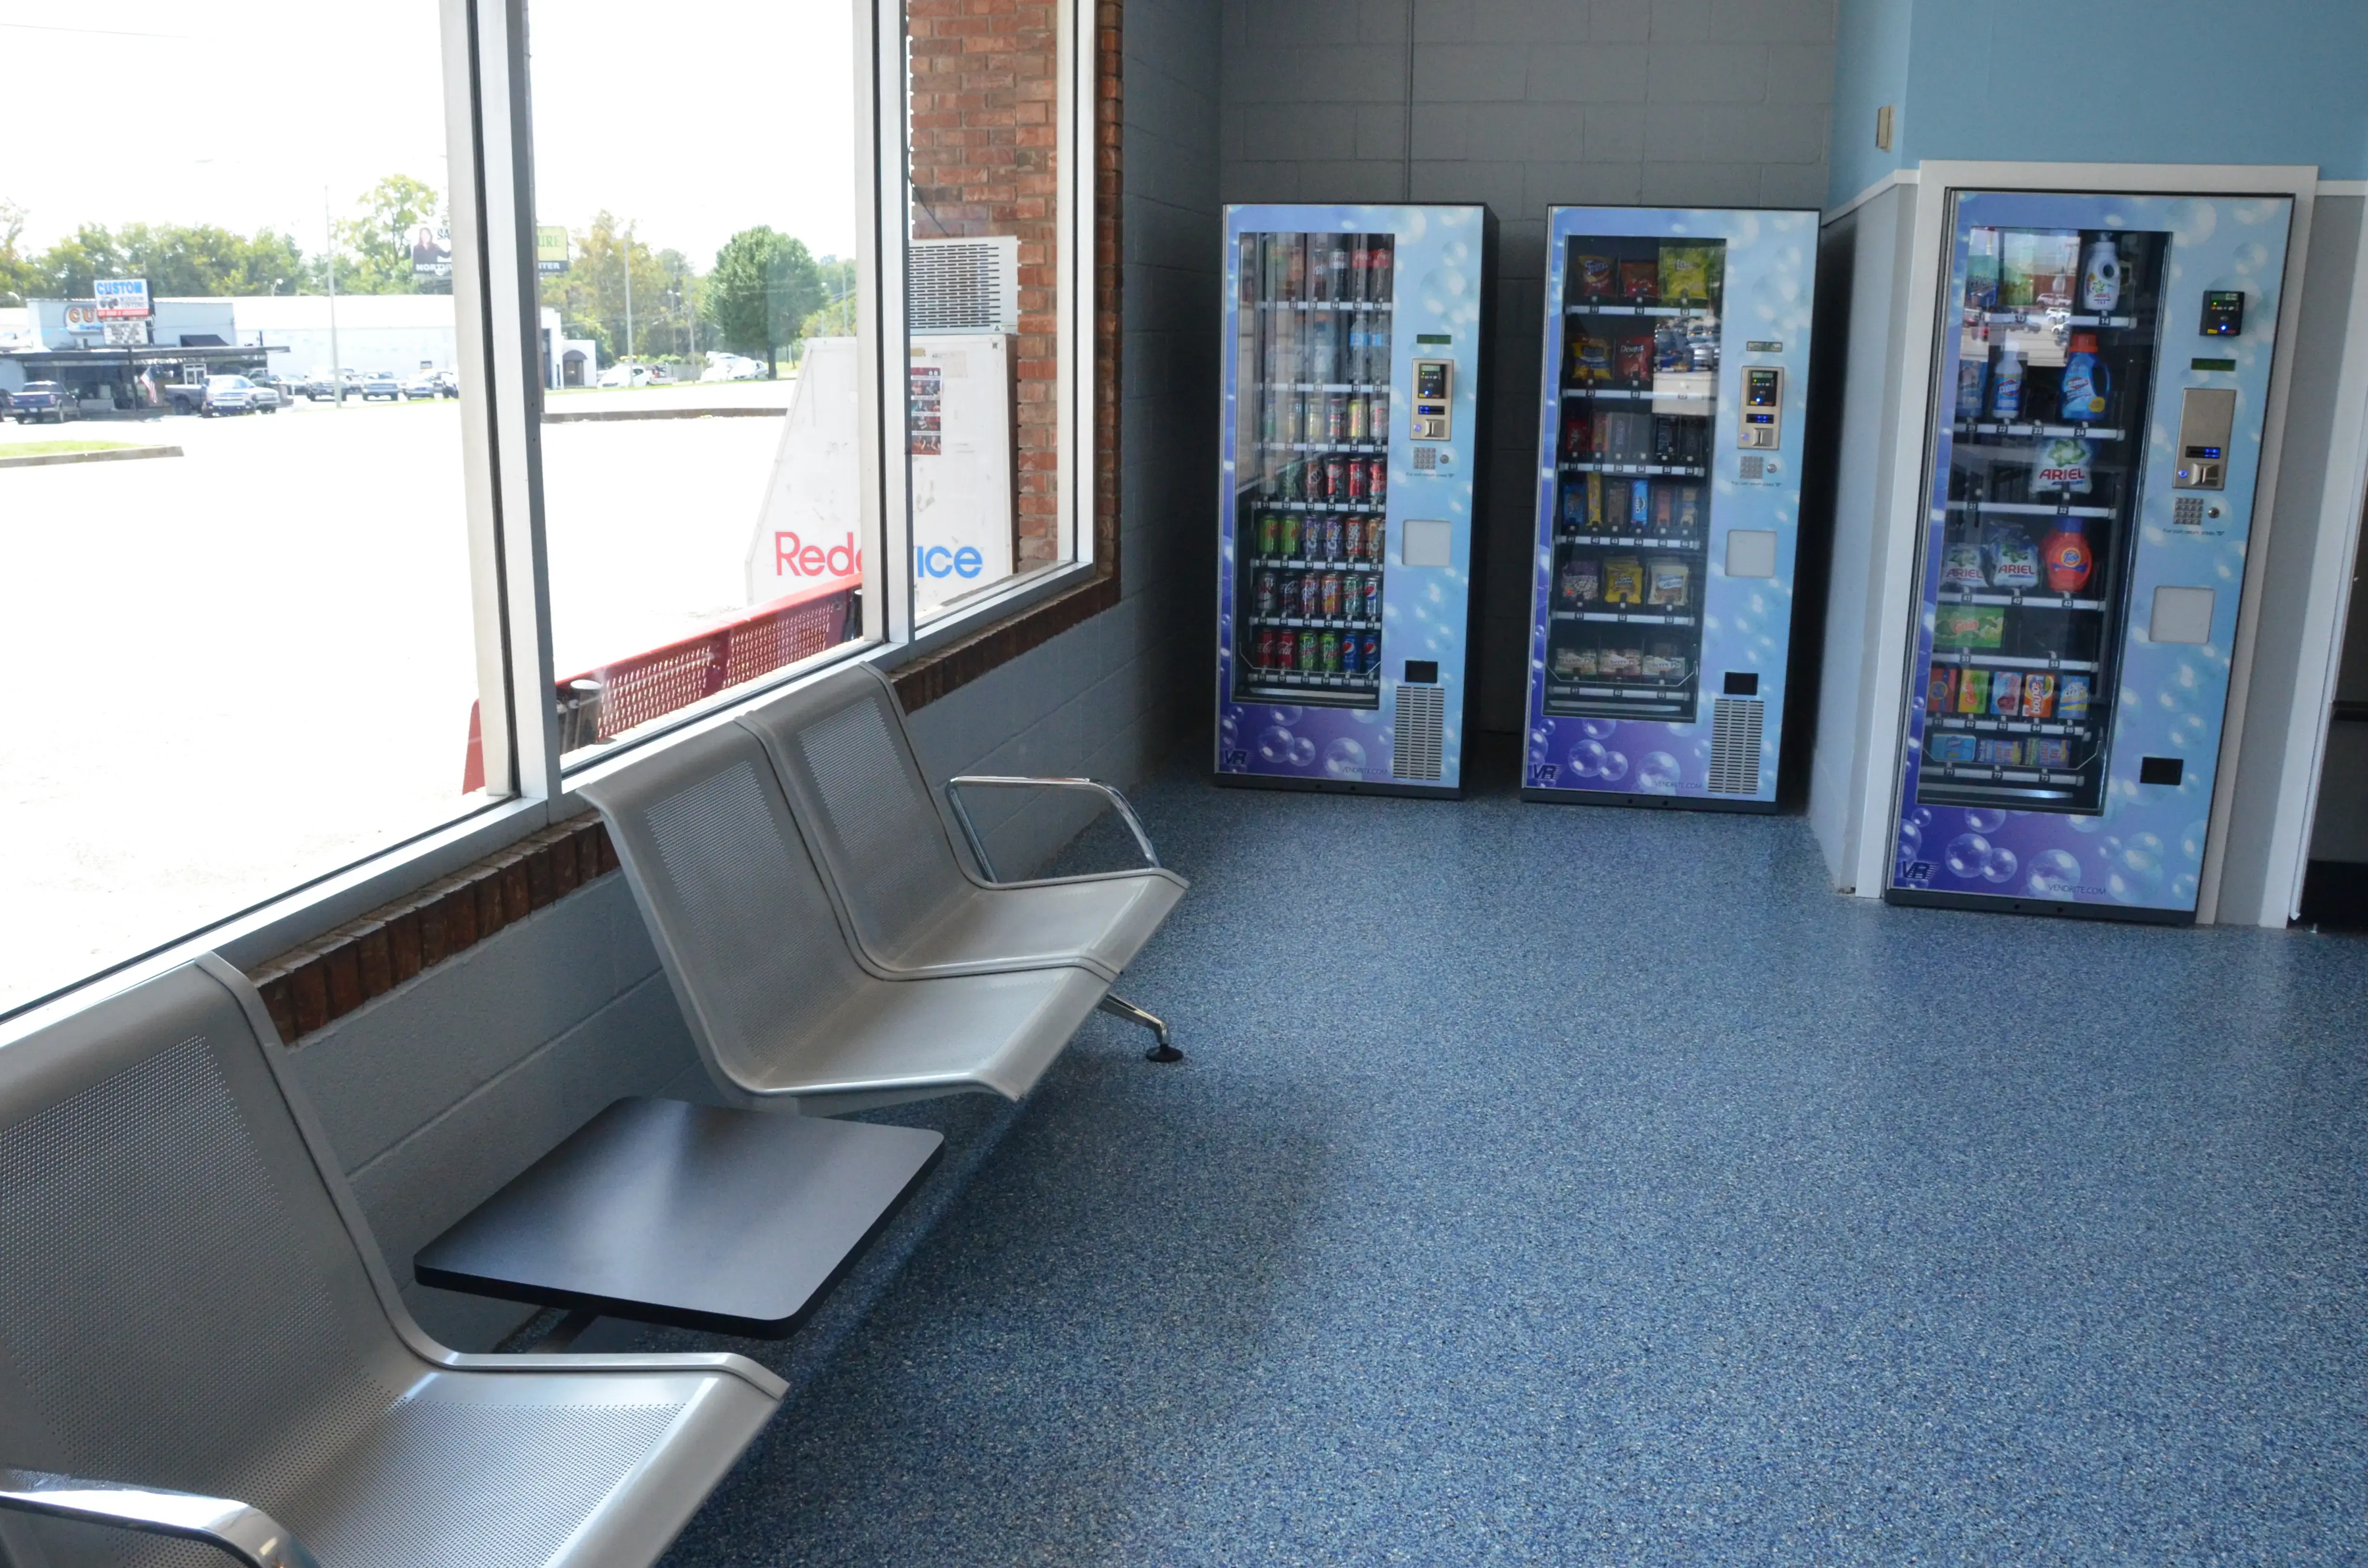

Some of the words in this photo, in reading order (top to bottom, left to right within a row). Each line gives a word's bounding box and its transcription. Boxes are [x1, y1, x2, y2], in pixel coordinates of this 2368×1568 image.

[97, 282, 143, 295] CUSTOM
[2039, 468, 2085, 480] ARIEL
[2063, 552, 2080, 563] Tide
[1946, 568, 1983, 578] ARIEL
[1998, 564, 2035, 575] ARIEL
[1954, 620, 1979, 631] Gain
[2031, 682, 2042, 714] bounce
[1533, 764, 1556, 779] VR
[1903, 861, 1929, 879] VR
[2048, 884, 2106, 894] VENDRITE.COM
